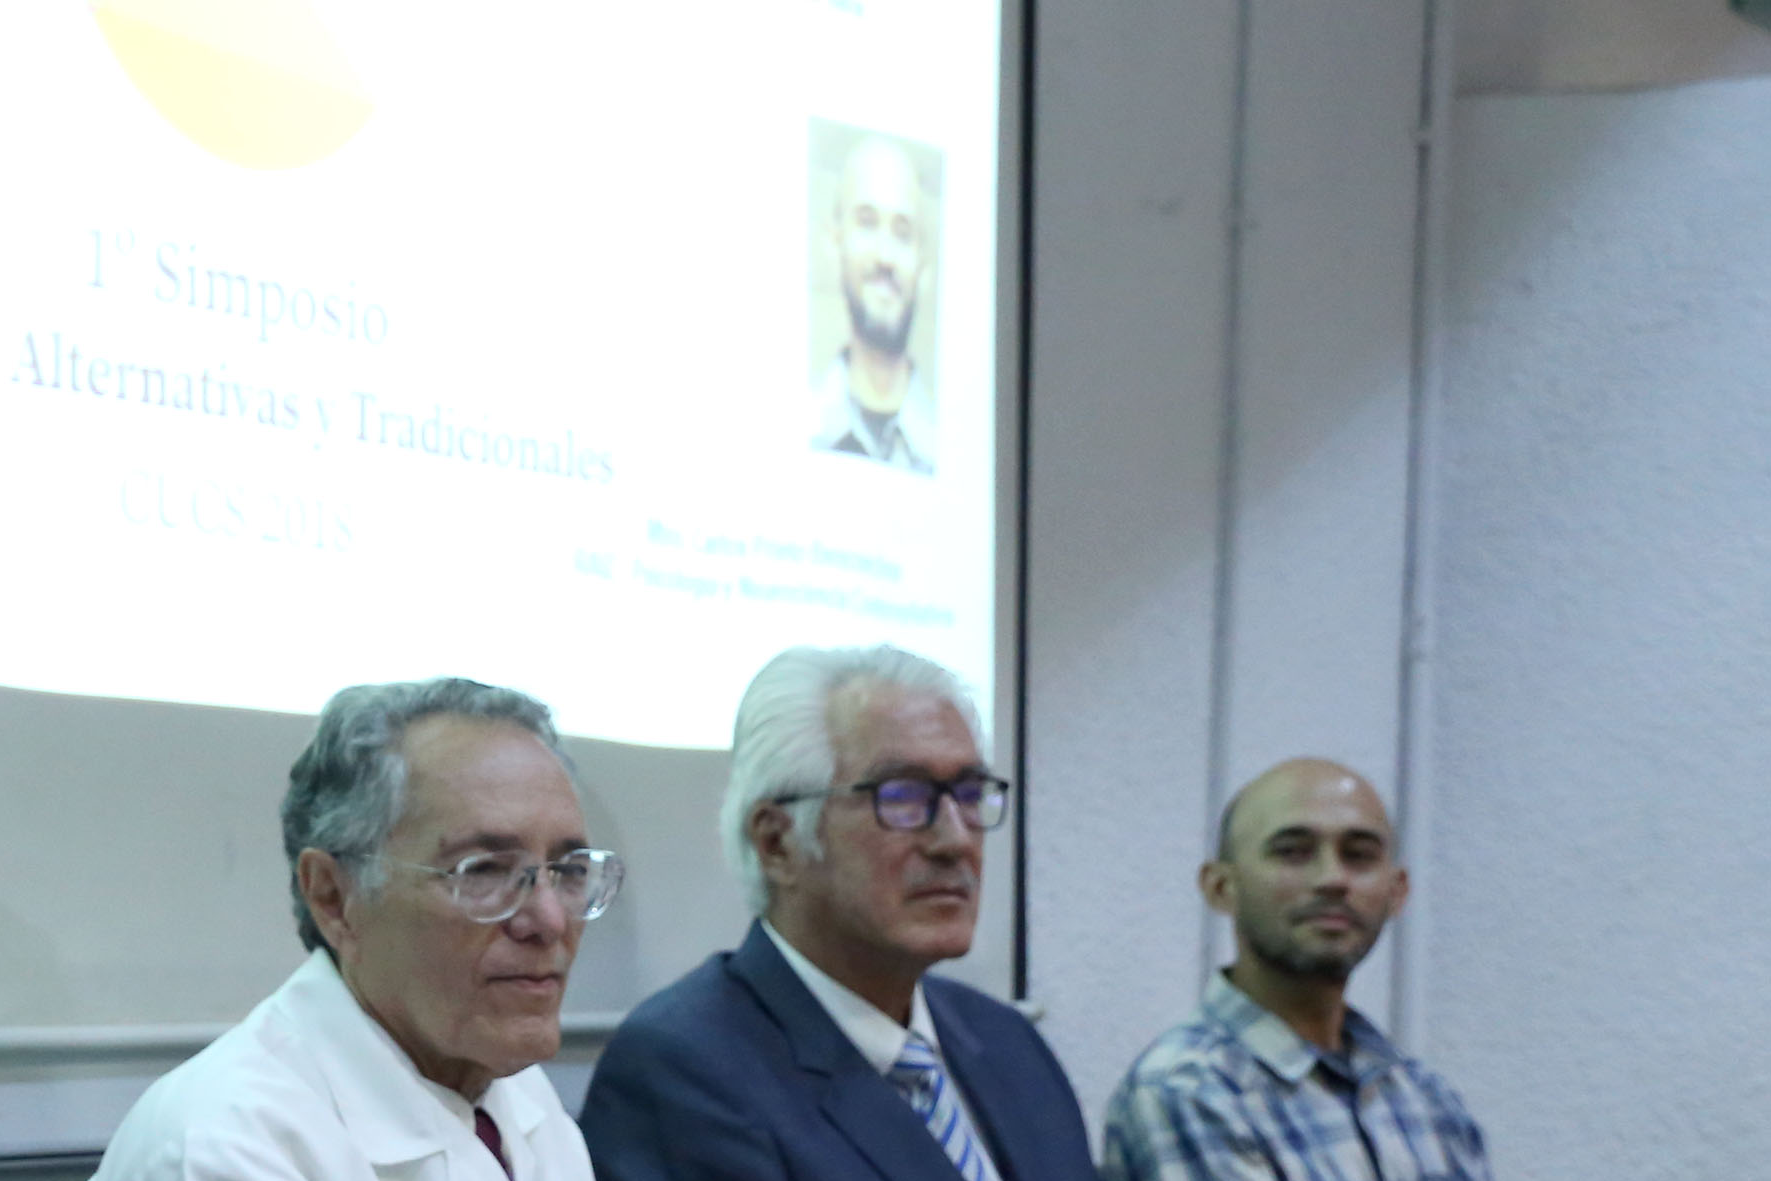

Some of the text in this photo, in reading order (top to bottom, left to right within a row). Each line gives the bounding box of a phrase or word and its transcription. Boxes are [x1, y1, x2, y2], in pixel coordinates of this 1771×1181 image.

[154, 240, 390, 346] Simposio
[11, 329, 301, 431] Alternativas
[313, 395, 337, 452] y
[349, 387, 616, 484] Tradicionales
